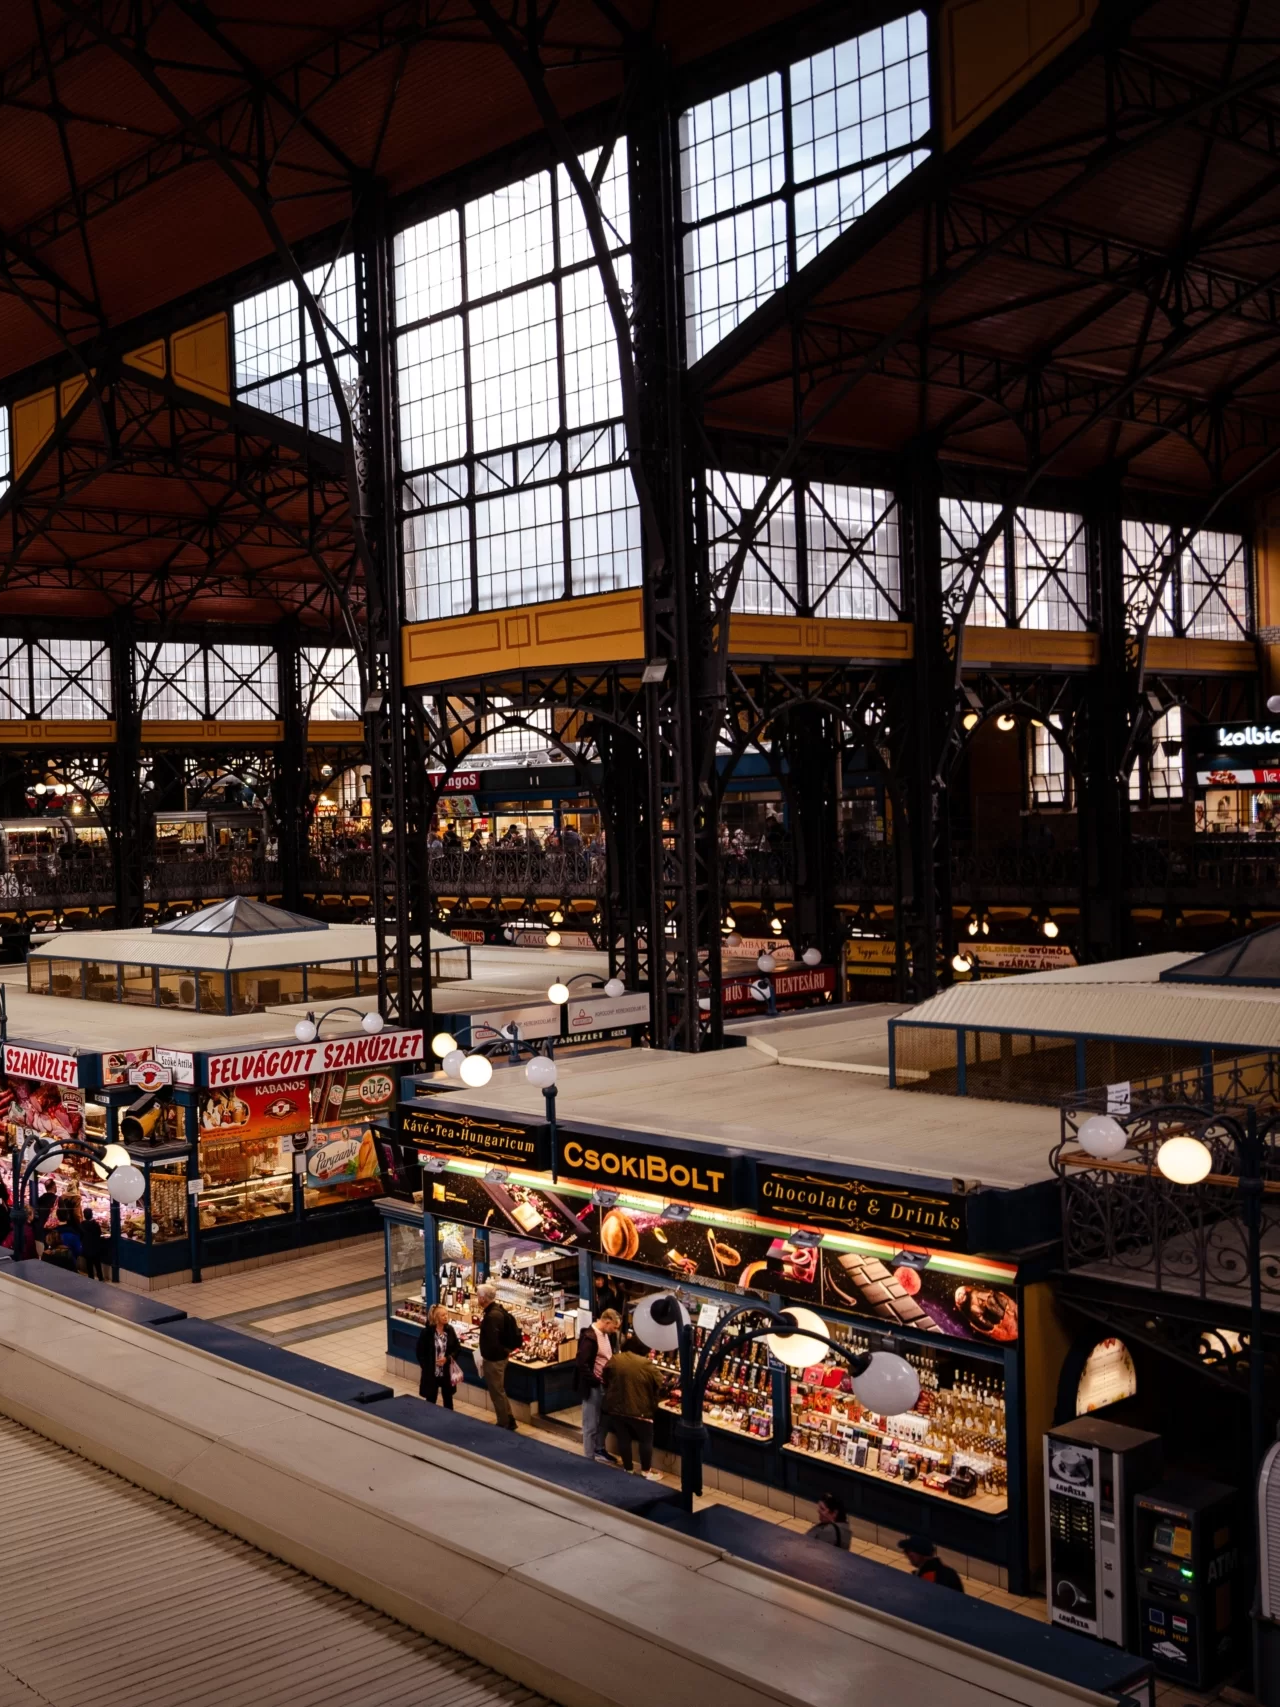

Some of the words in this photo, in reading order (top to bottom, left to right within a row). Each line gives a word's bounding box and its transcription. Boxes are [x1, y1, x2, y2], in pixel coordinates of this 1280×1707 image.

[434, 773, 477, 789] LngoS
[725, 980, 743, 1001] HÚS
[775, 970, 825, 994] HENTESÁRU
[6, 1048, 78, 1084] SZAKÜZLET
[210, 1048, 317, 1085] FELVÁGOTT
[324, 1034, 422, 1069] SZAKÜZLET
[255, 1080, 307, 1096] KABANOS
[403, 1118, 430, 1134] Kávé
[436, 1122, 455, 1138] Tea
[460, 1128, 536, 1154] Hungaricum
[762, 1180, 858, 1213] Chocolate
[867, 1198, 881, 1215] &
[890, 1202, 961, 1231] Drinks
[1207, 1548, 1239, 1584] ATM
[1148, 1624, 1166, 1637] EUR
